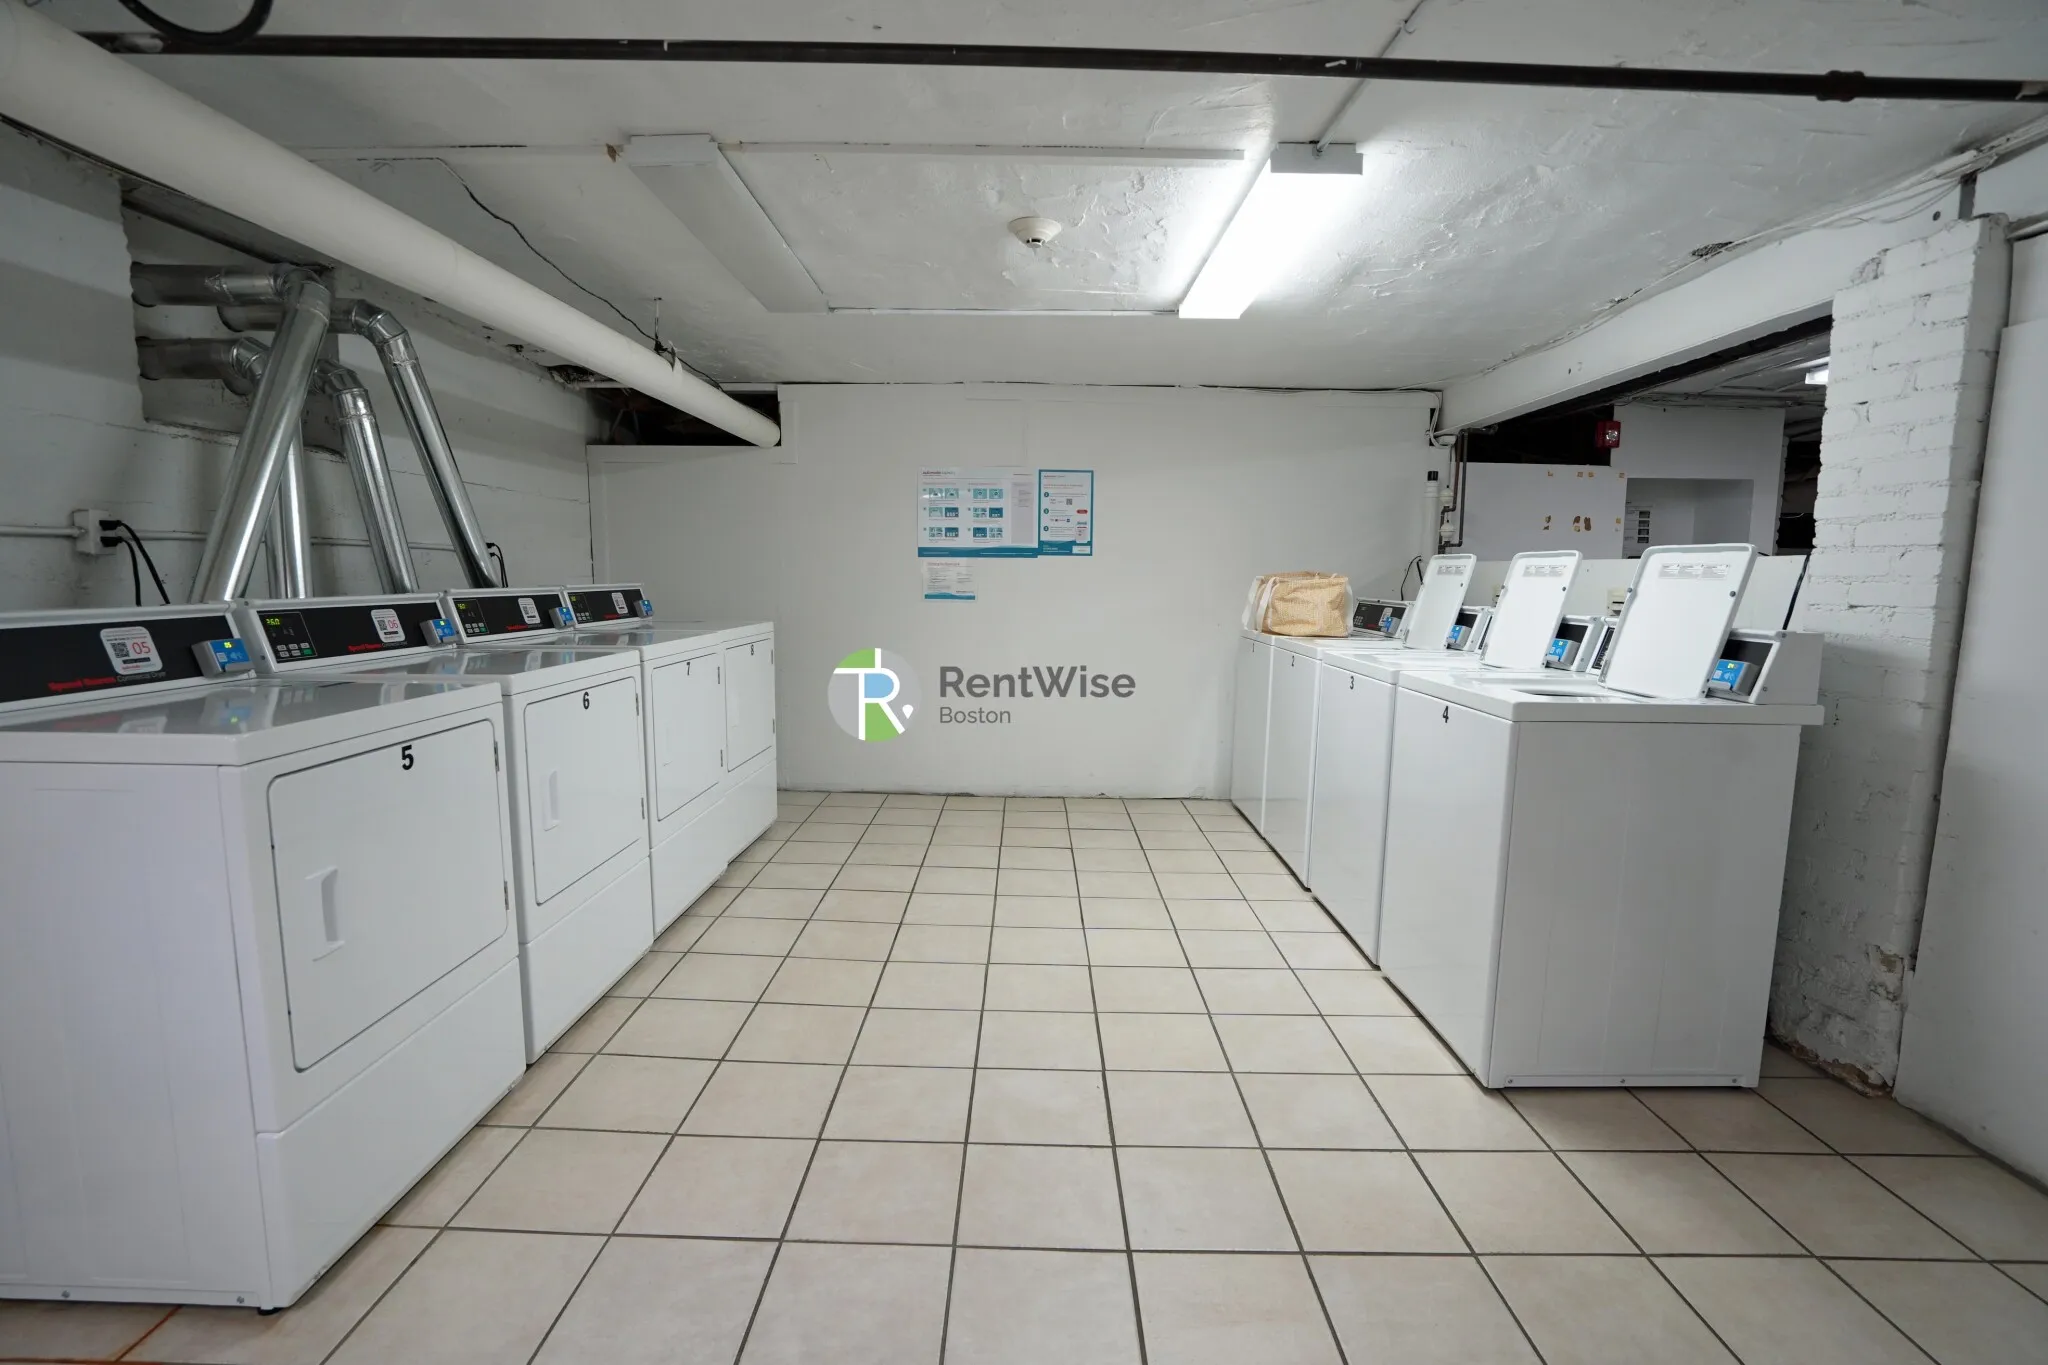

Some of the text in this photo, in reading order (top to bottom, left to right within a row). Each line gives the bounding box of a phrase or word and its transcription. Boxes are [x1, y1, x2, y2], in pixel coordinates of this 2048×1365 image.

[132, 641, 151, 655] 05
[750, 644, 755, 656] 8
[1291, 655, 1295, 667] 2
[685, 661, 691, 676] 7
[1350, 676, 1355, 690] 3
[582, 691, 590, 710] 6
[1442, 705, 1449, 723] 4
[401, 744, 415, 771] 5
